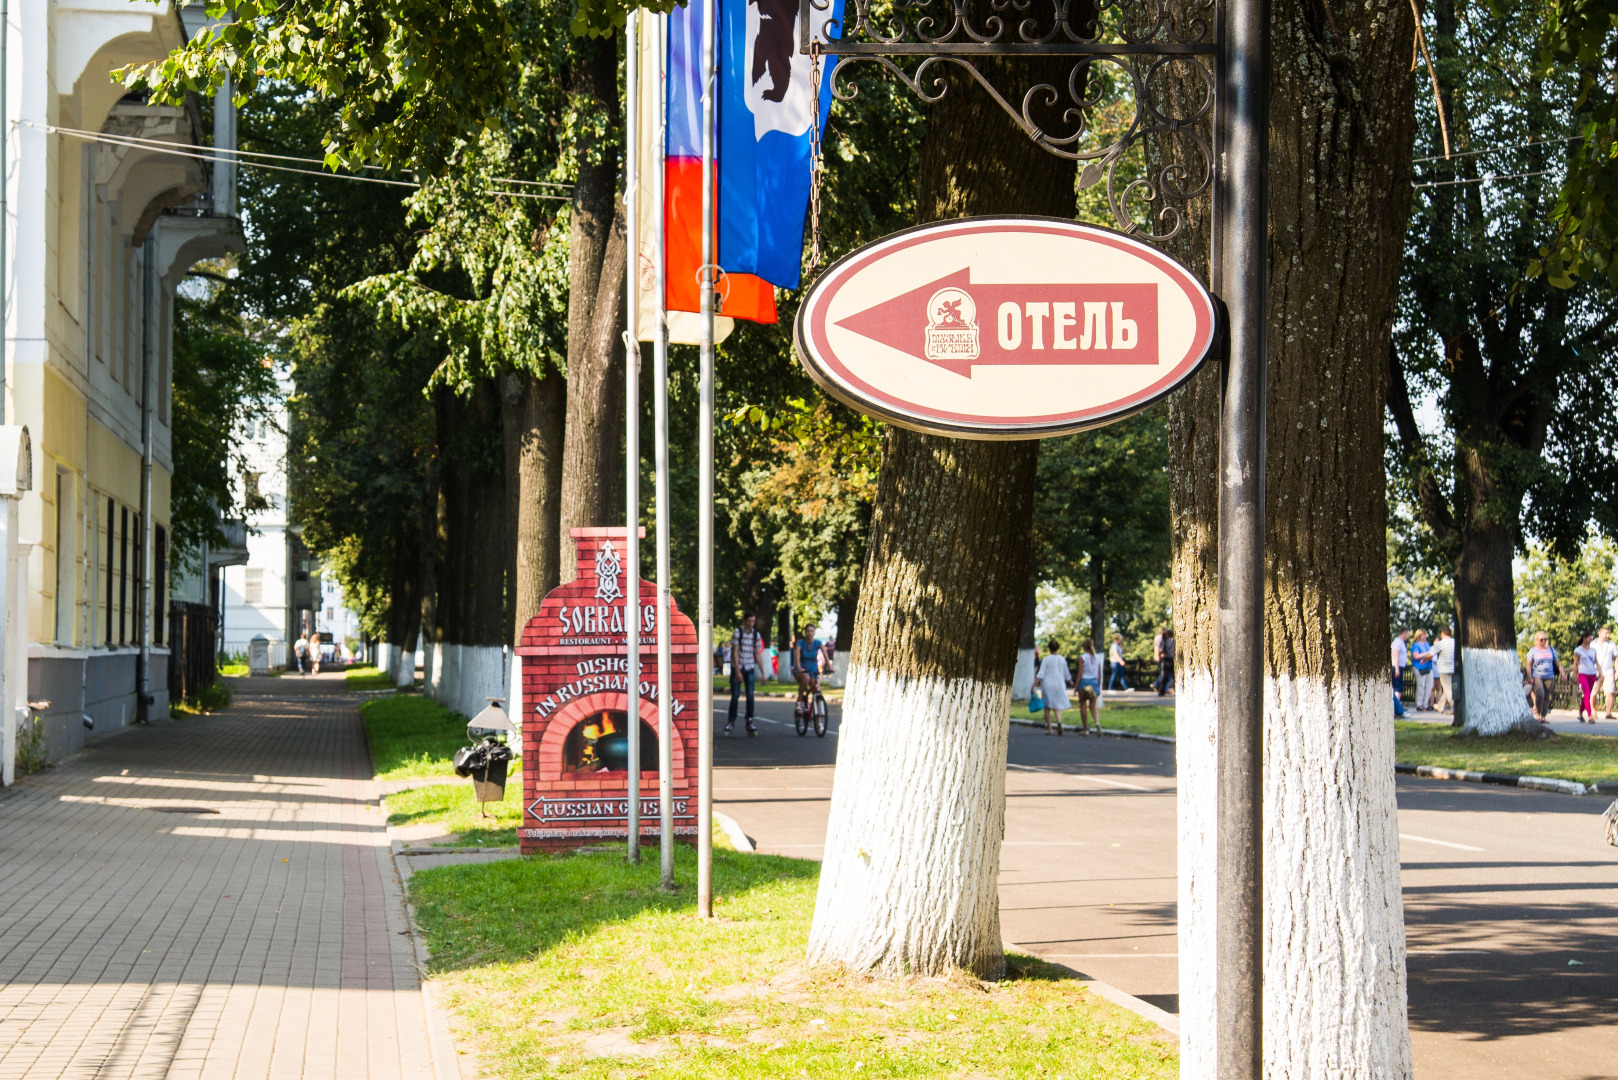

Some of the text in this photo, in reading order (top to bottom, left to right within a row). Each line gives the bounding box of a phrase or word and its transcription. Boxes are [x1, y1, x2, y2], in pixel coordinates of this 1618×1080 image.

[997, 301, 1138, 350] ОТЕЛЬ
[560, 637, 611, 645] RESTORAUNT
[535, 695, 557, 718] IN
[639, 681, 686, 716] OVN
[543, 801, 688, 817] RUSSIAN CISE
